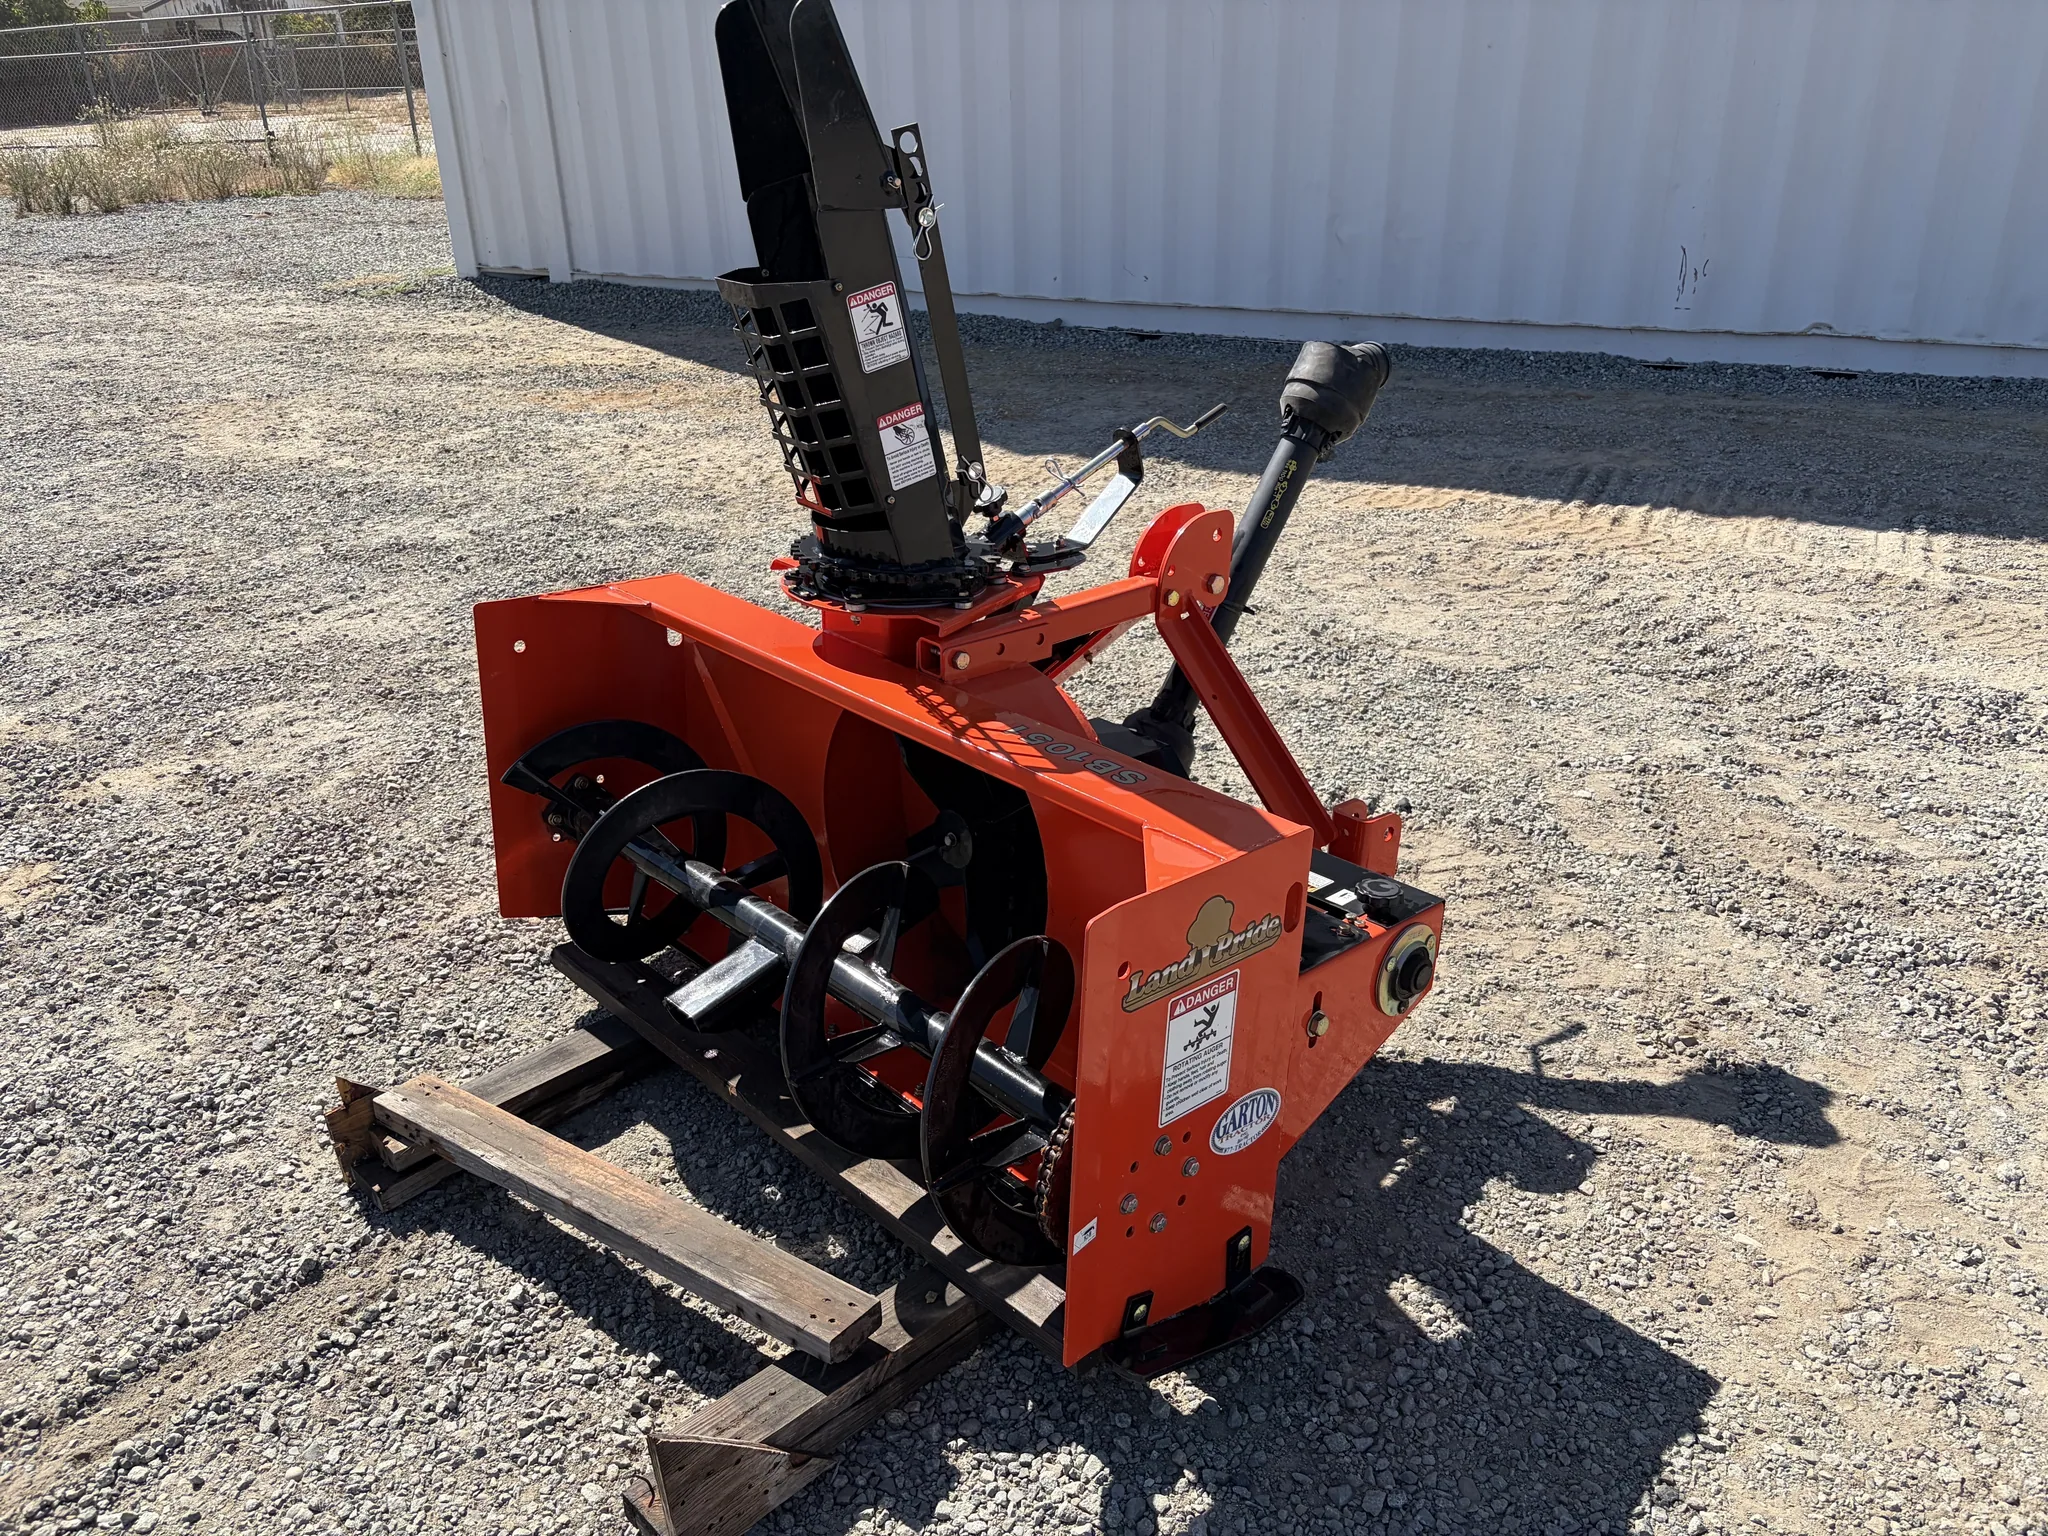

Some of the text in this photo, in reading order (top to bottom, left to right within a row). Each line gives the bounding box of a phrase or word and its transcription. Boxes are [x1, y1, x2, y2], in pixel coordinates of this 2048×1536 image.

[857, 285, 894, 304] DANGER
[886, 404, 923, 425] DANGER
[1123, 912, 1283, 1005] Land Pride
[1186, 977, 1235, 1009] DANGER
[1173, 1041, 1223, 1073] ROTATING AUGER
[1216, 1093, 1275, 1139] GARTON
[1218, 1113, 1271, 1144] TRACTOR
